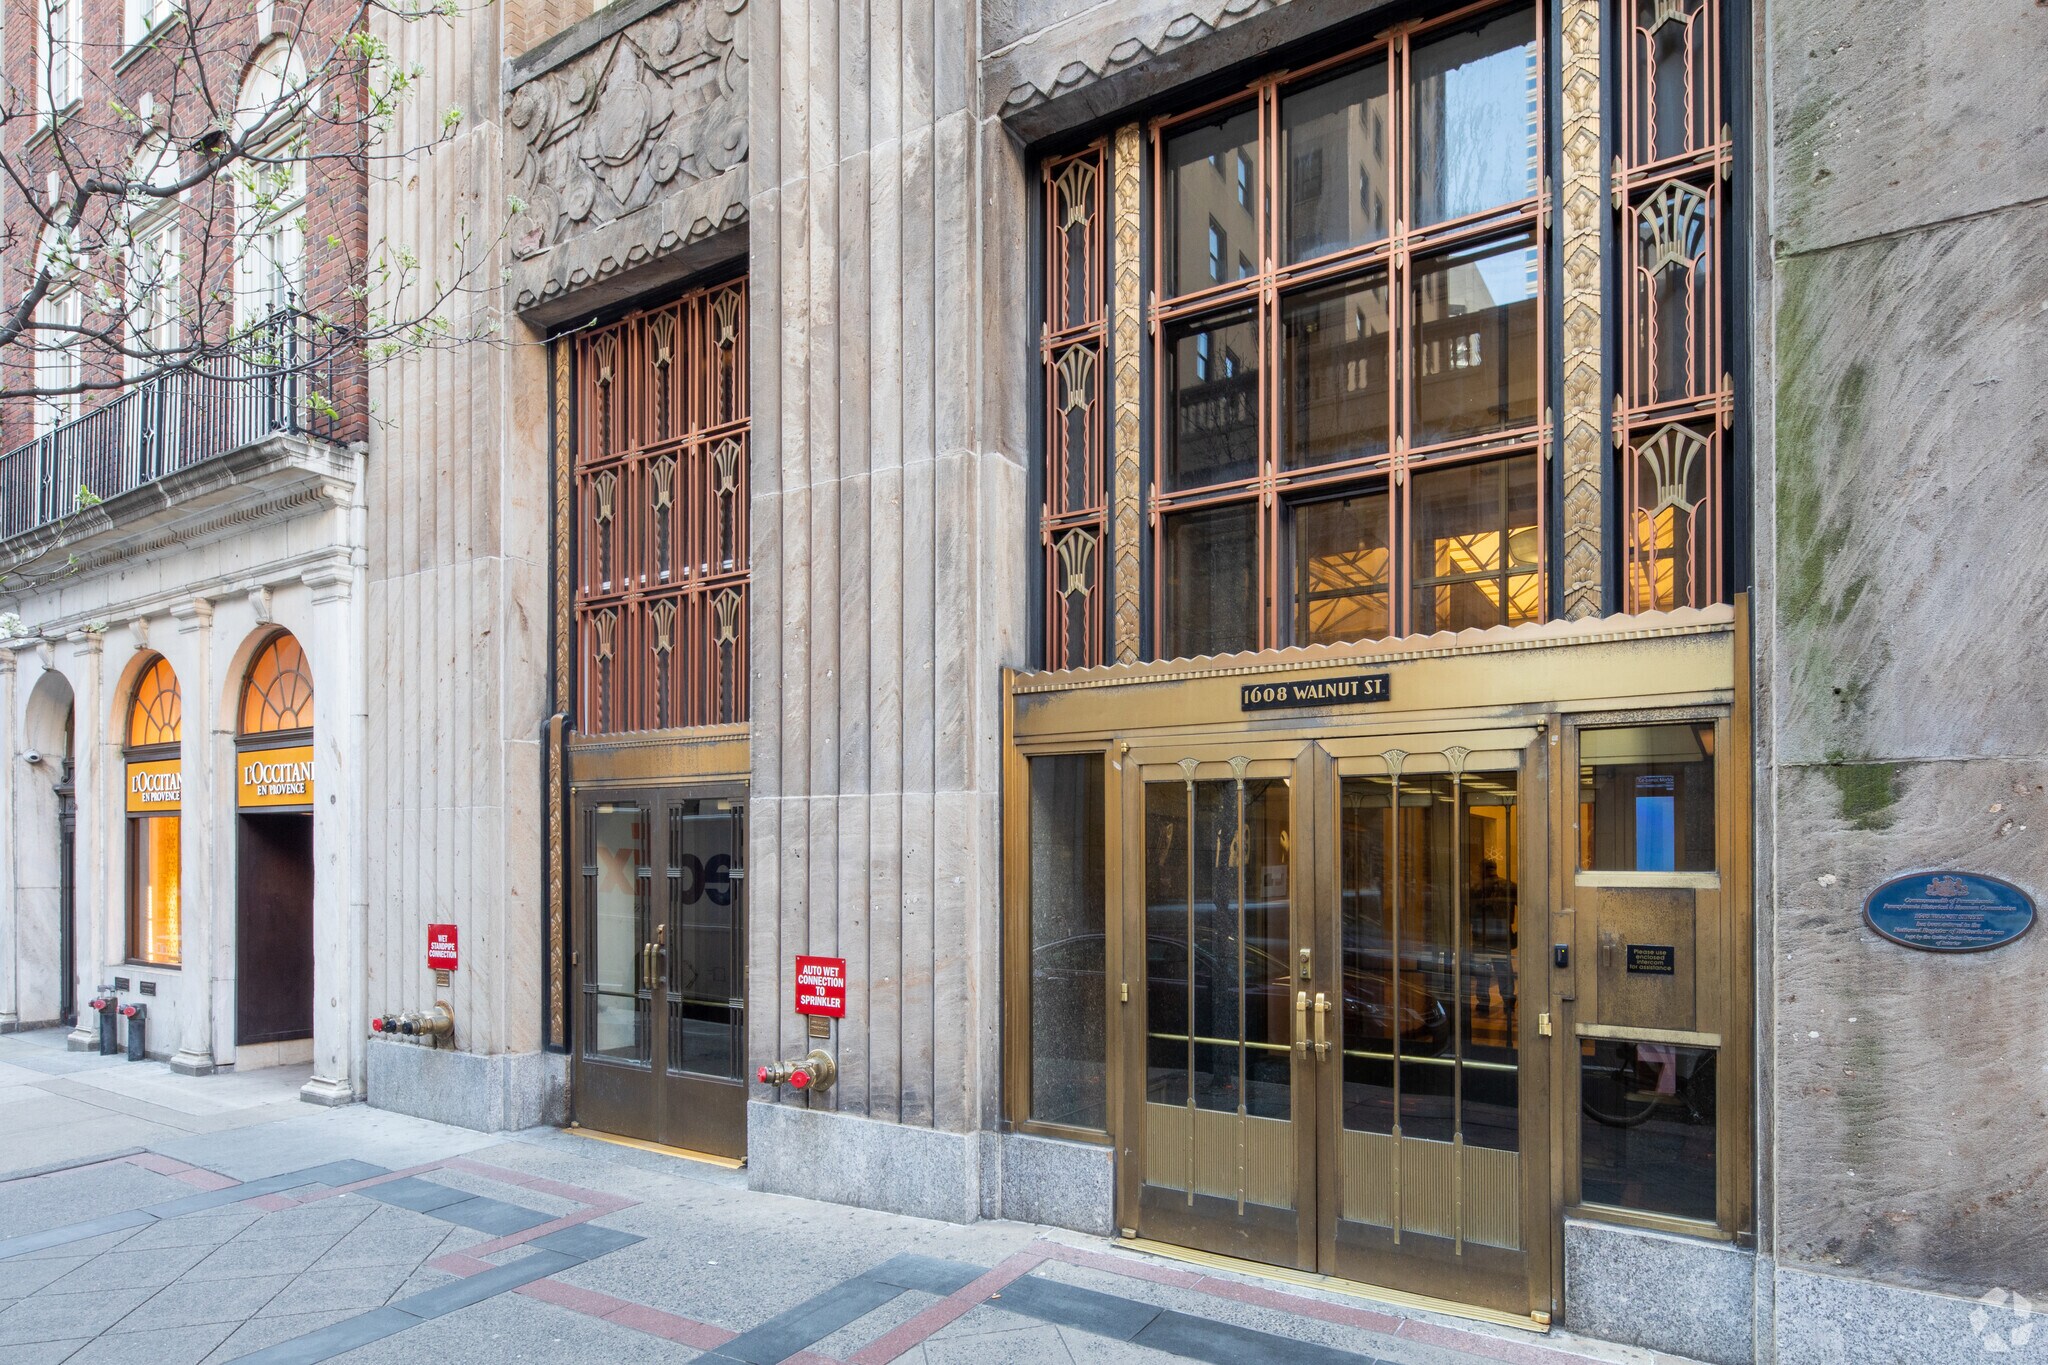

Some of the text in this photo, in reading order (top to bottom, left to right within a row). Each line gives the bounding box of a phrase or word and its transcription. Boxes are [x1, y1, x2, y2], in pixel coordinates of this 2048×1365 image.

[1244, 686, 1287, 704] 1608
[1293, 681, 1359, 700] WALNUT
[244, 761, 315, 785] L'OCCITAN
[257, 783, 305, 796] EN PROVENCE
[142, 791, 181, 802] EN PROVENCE
[429, 950, 457, 958] CONNECTION
[803, 965, 839, 977] AUTO WET
[798, 975, 844, 987] CONNECTION
[815, 986, 825, 996] TO
[800, 995, 841, 1008] SPRINKLER
